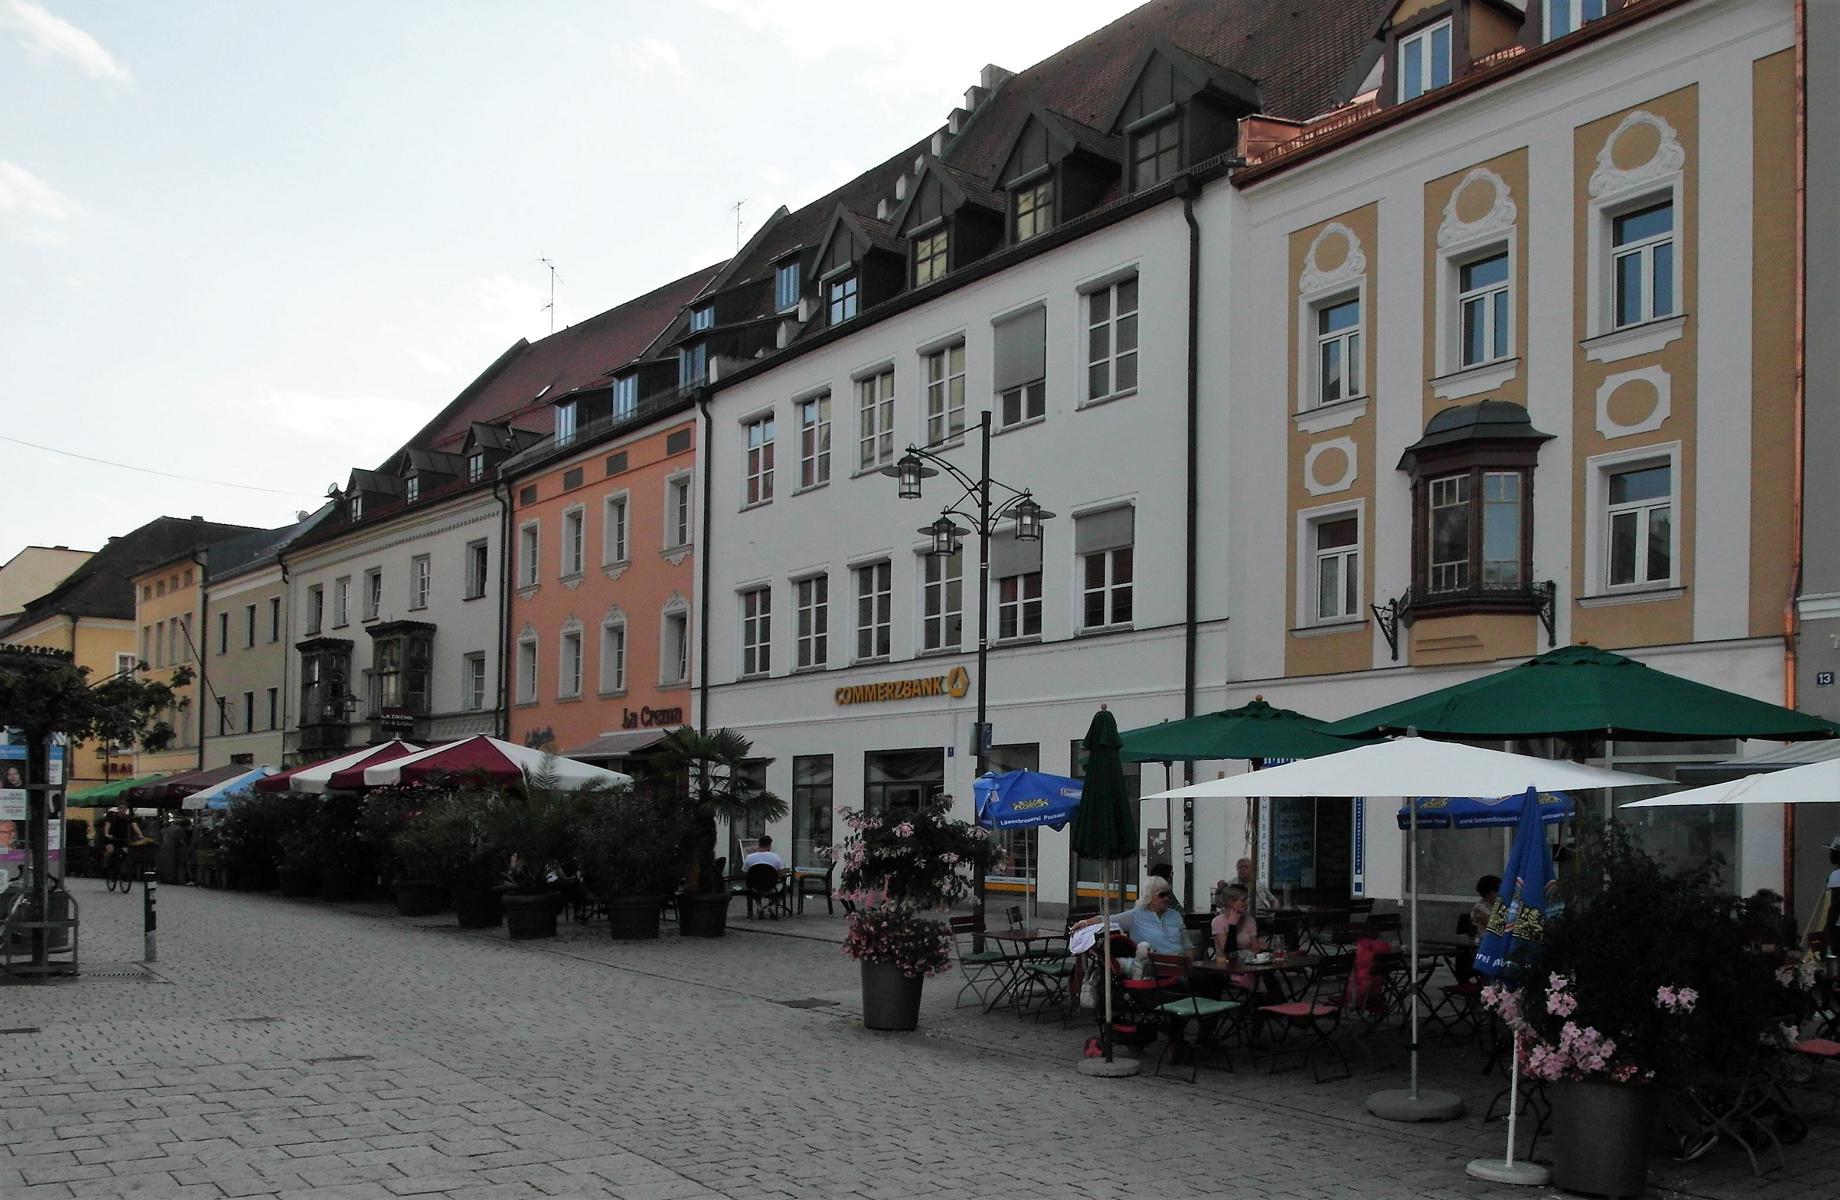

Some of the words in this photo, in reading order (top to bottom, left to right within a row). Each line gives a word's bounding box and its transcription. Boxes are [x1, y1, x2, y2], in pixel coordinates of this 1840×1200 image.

[833, 676, 945, 706] COMMERZBANK
[1818, 673, 1832, 685] 13
[621, 708, 638, 729] La
[640, 705, 683, 727] Crema
